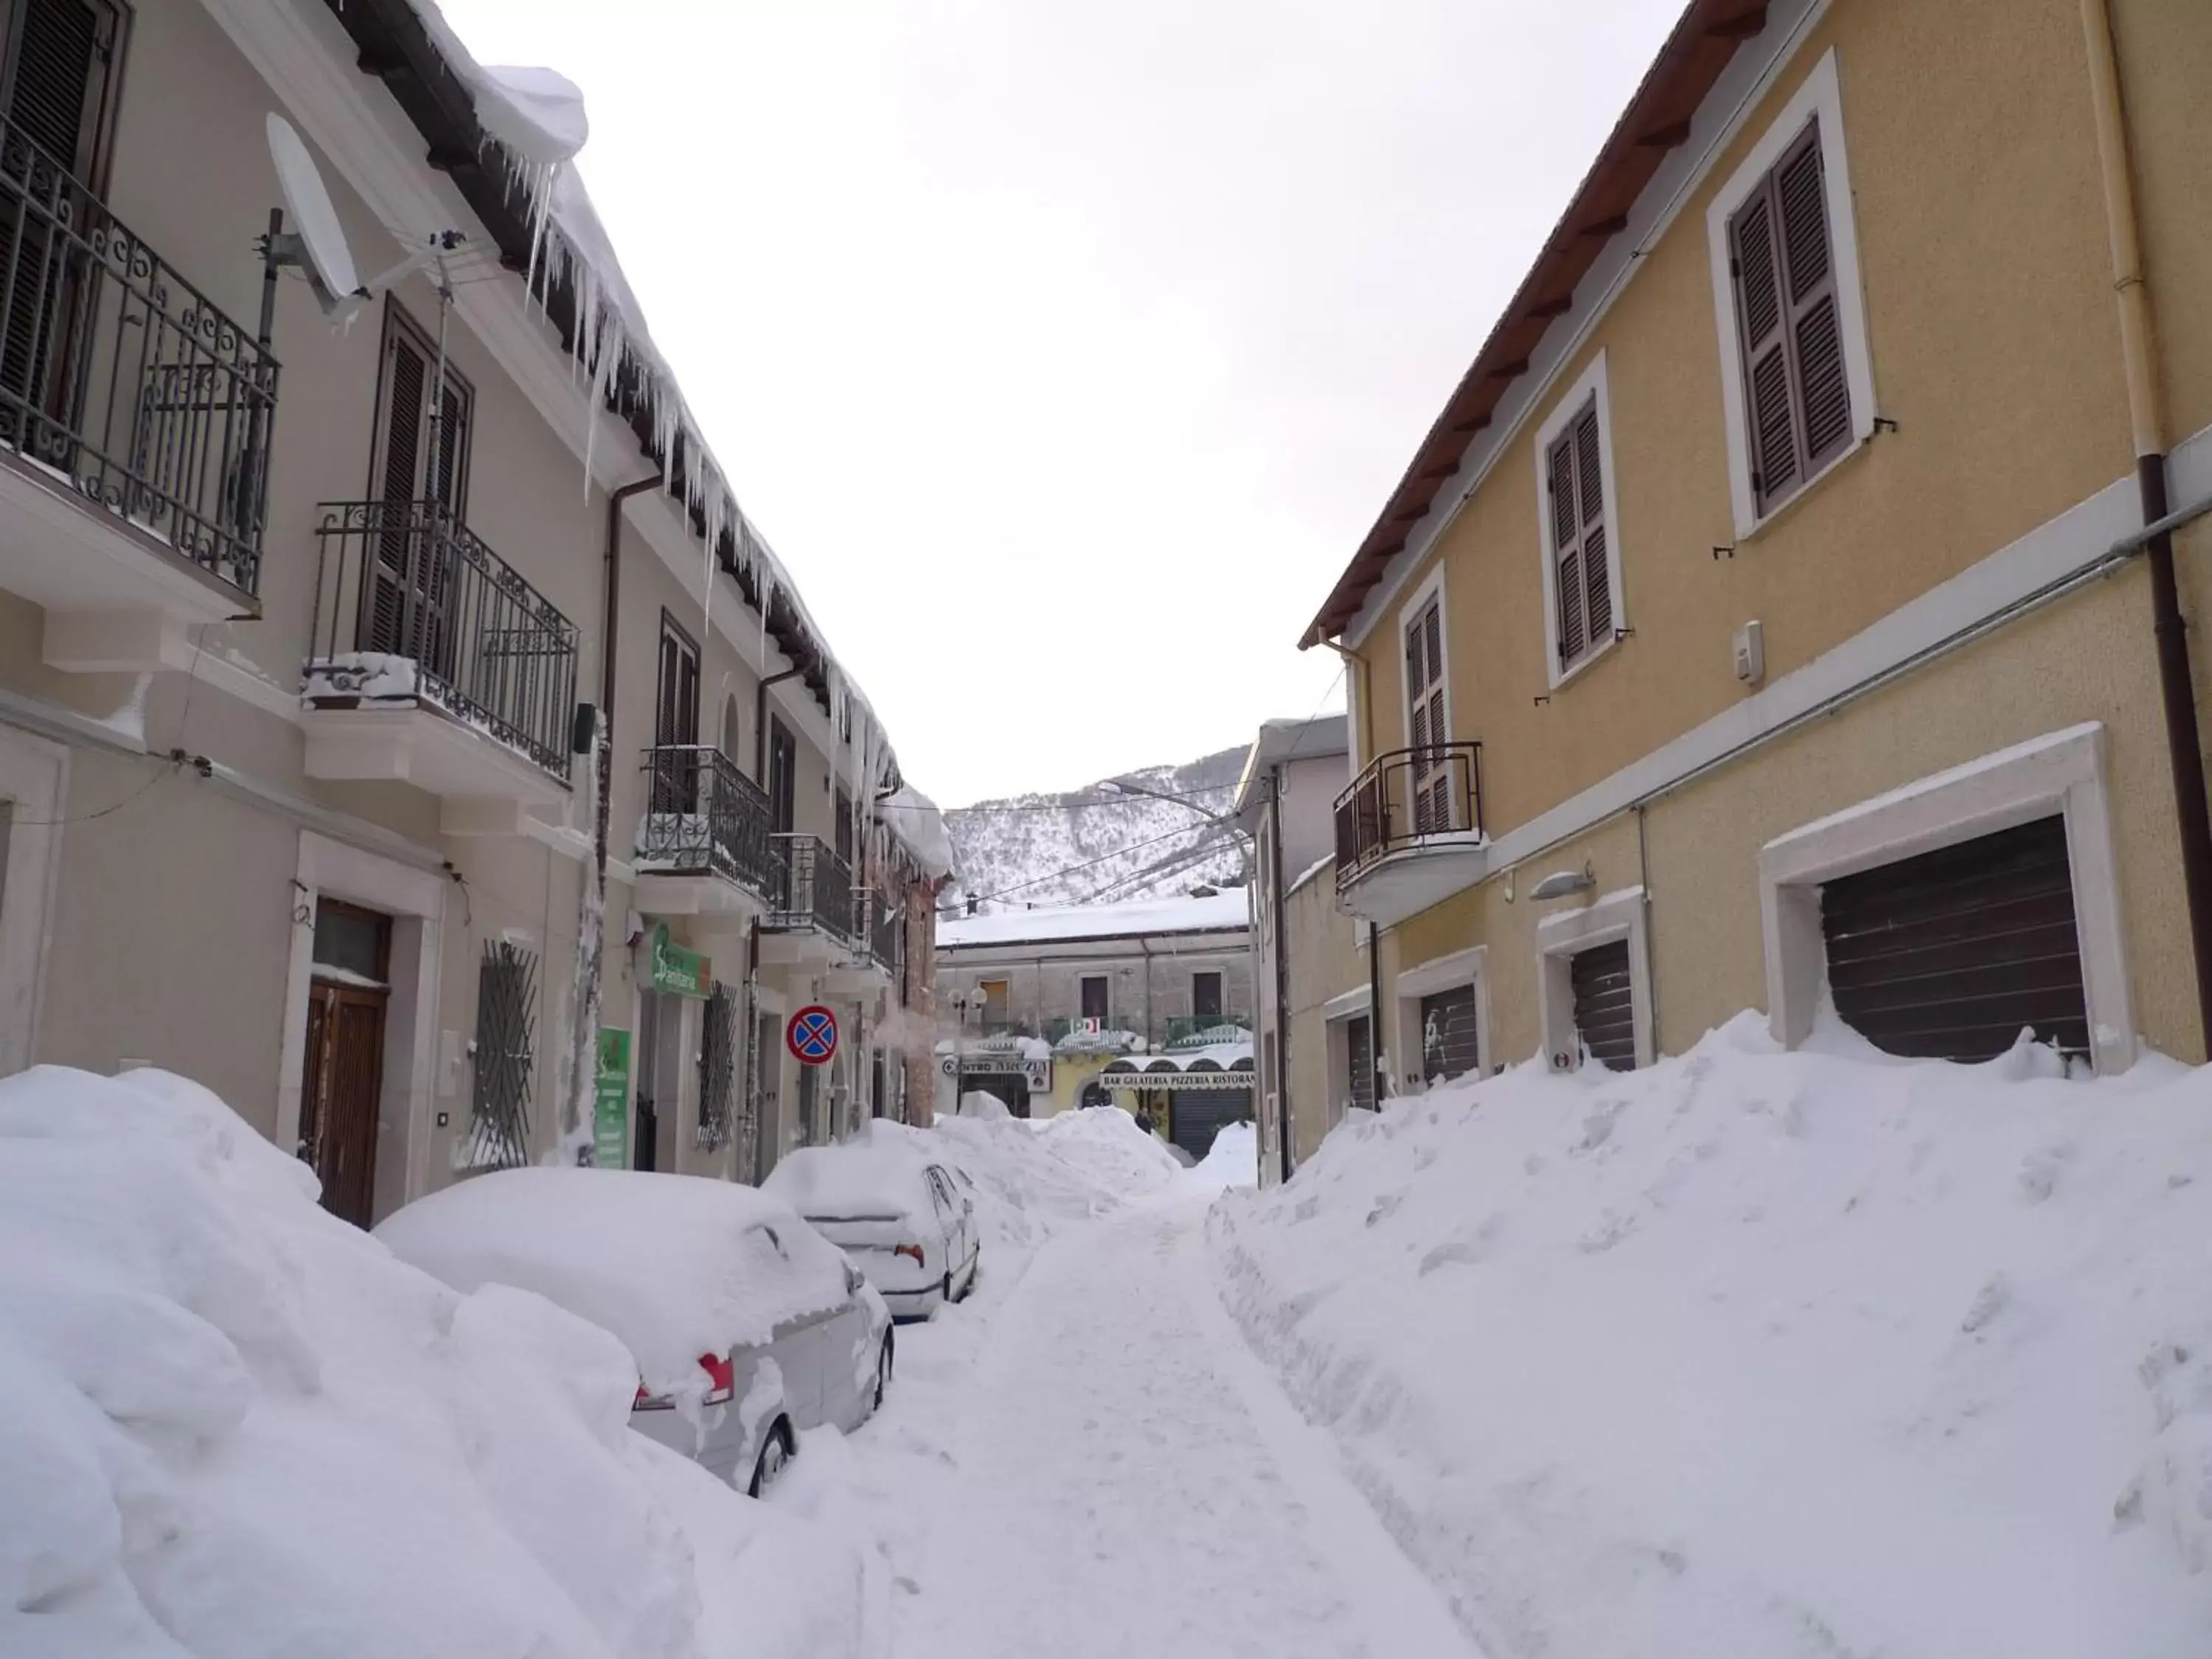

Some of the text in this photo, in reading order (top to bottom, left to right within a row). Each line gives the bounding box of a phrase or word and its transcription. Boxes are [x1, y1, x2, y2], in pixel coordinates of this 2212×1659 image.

[942, 1060, 992, 1074] CNTRO
[1104, 1075, 1121, 1085] BAR
[1123, 1075, 1168, 1085] GELATERIA
[1170, 1075, 1210, 1085] PIZZERIA
